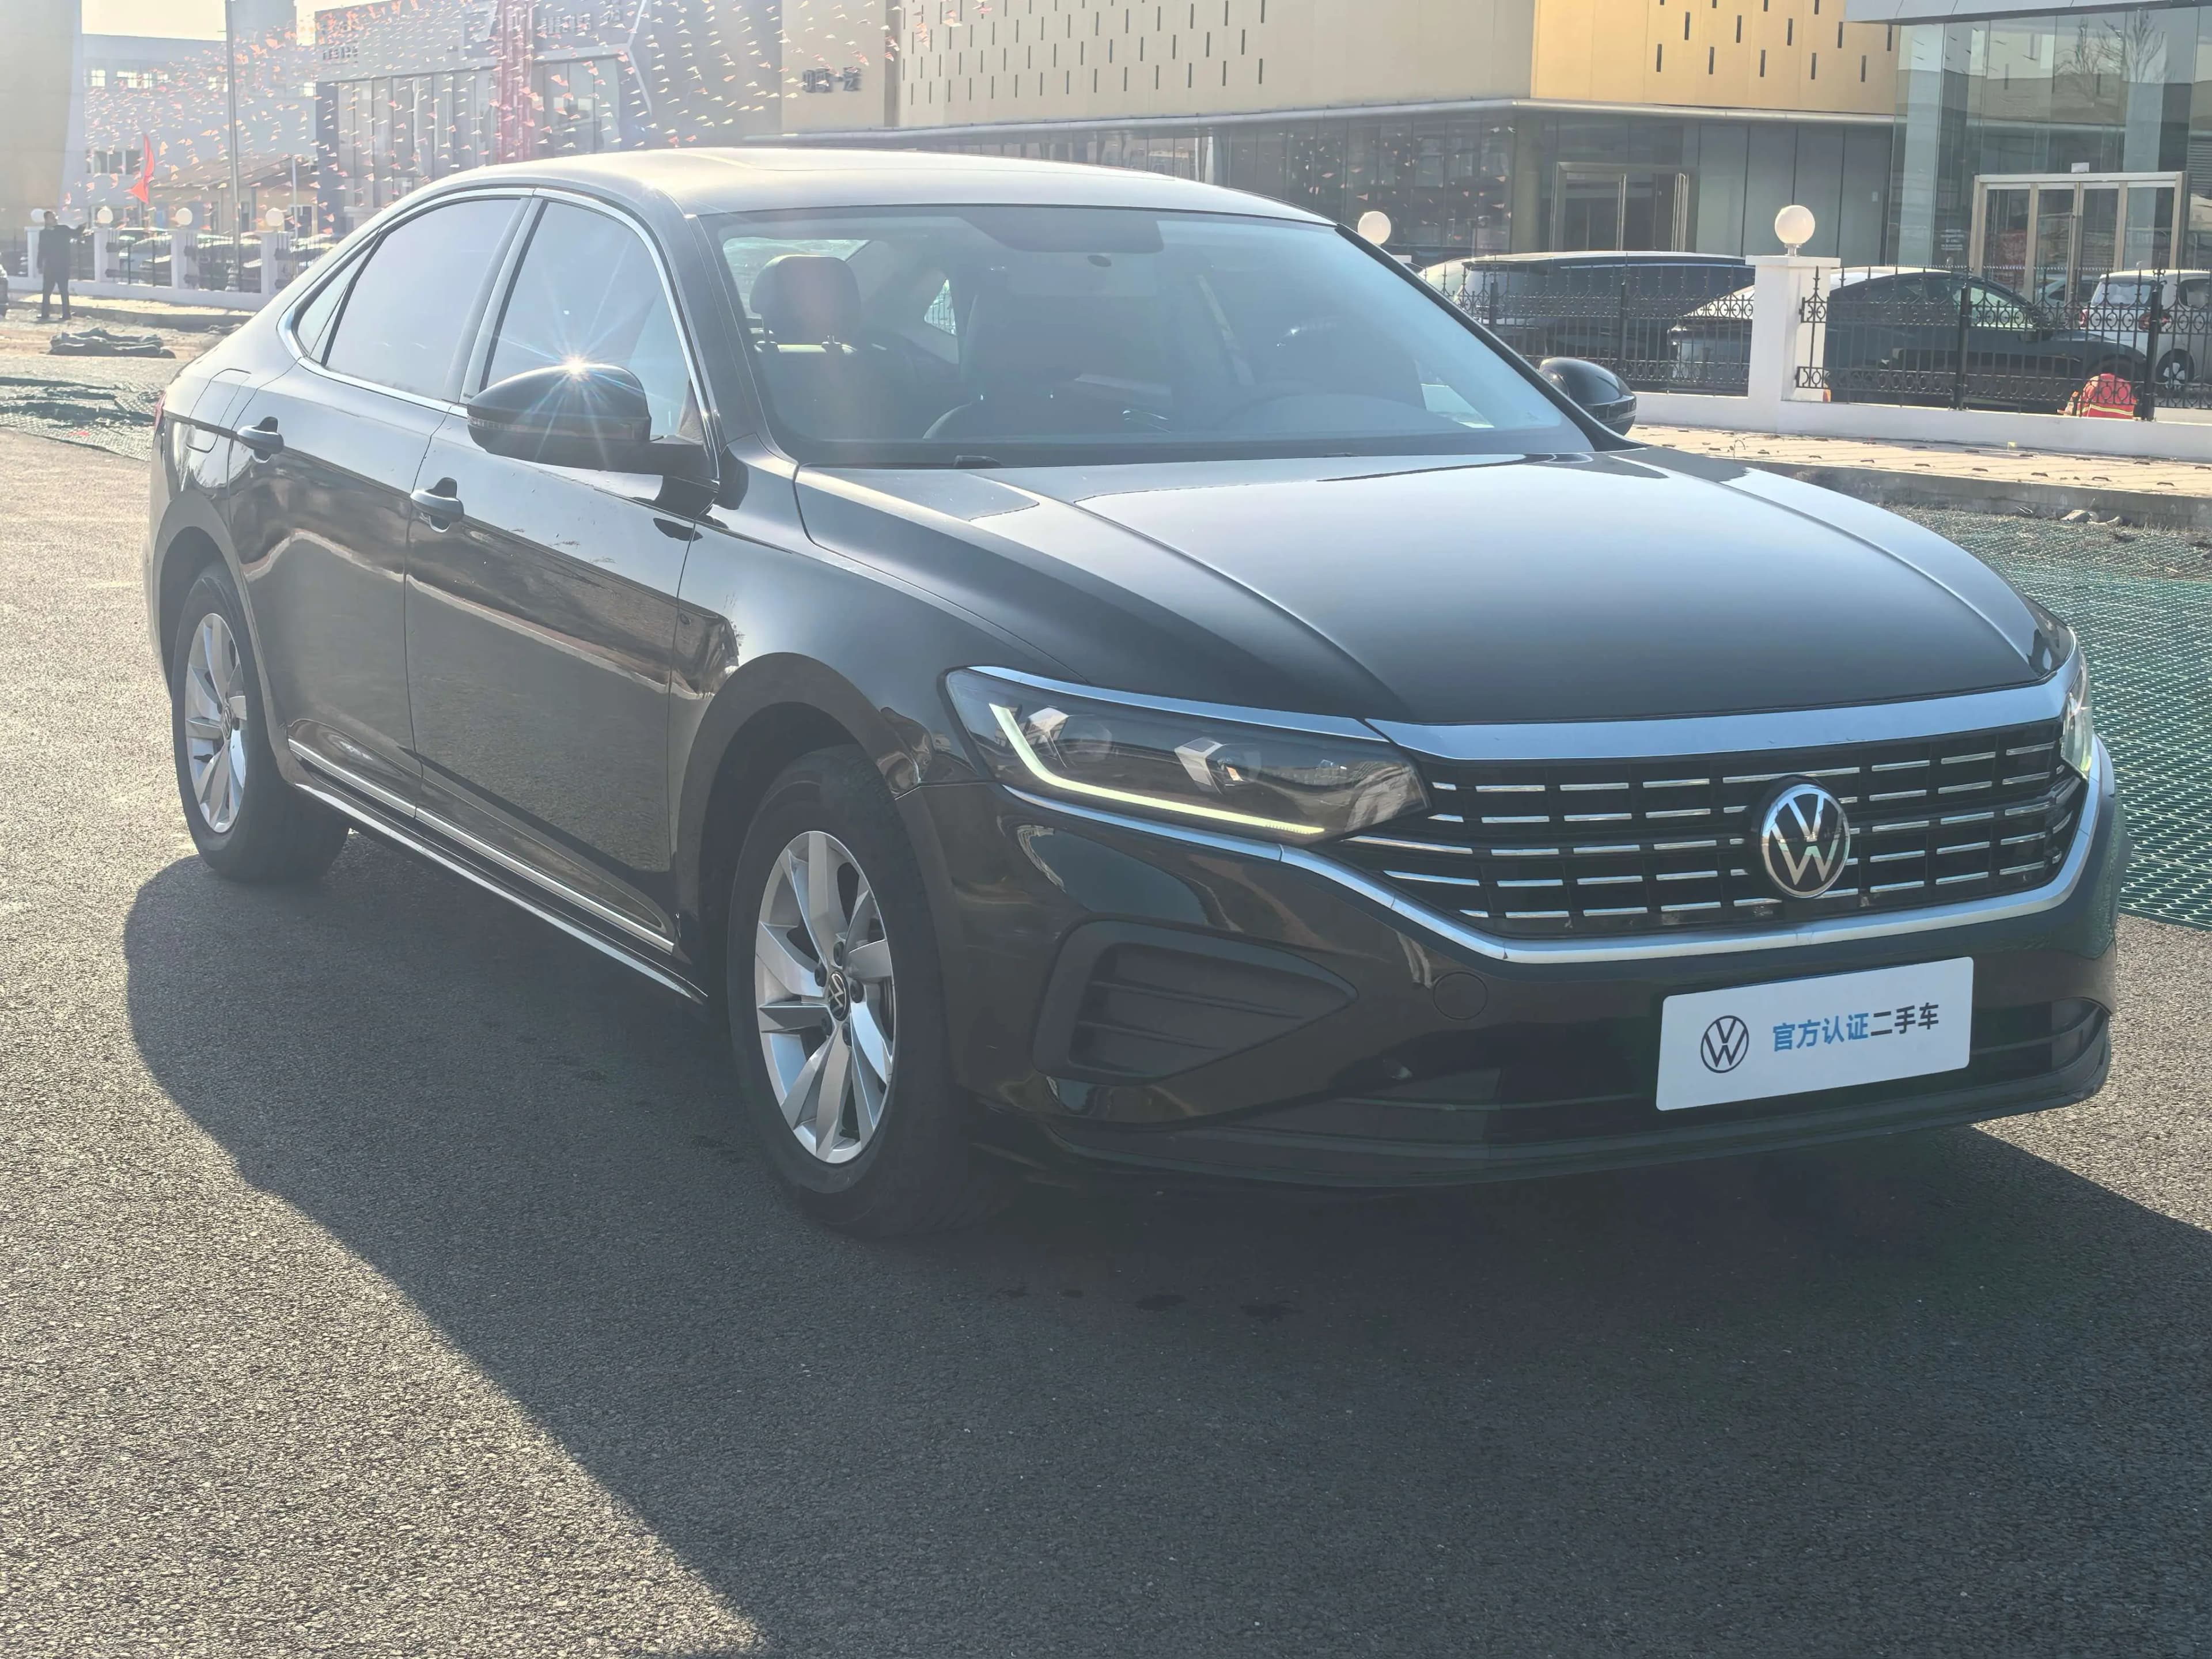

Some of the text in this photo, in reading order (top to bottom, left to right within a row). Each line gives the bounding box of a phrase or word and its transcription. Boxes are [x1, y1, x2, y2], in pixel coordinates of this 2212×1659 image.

[1772, 1002, 1939, 1051] 官方认证二手车
